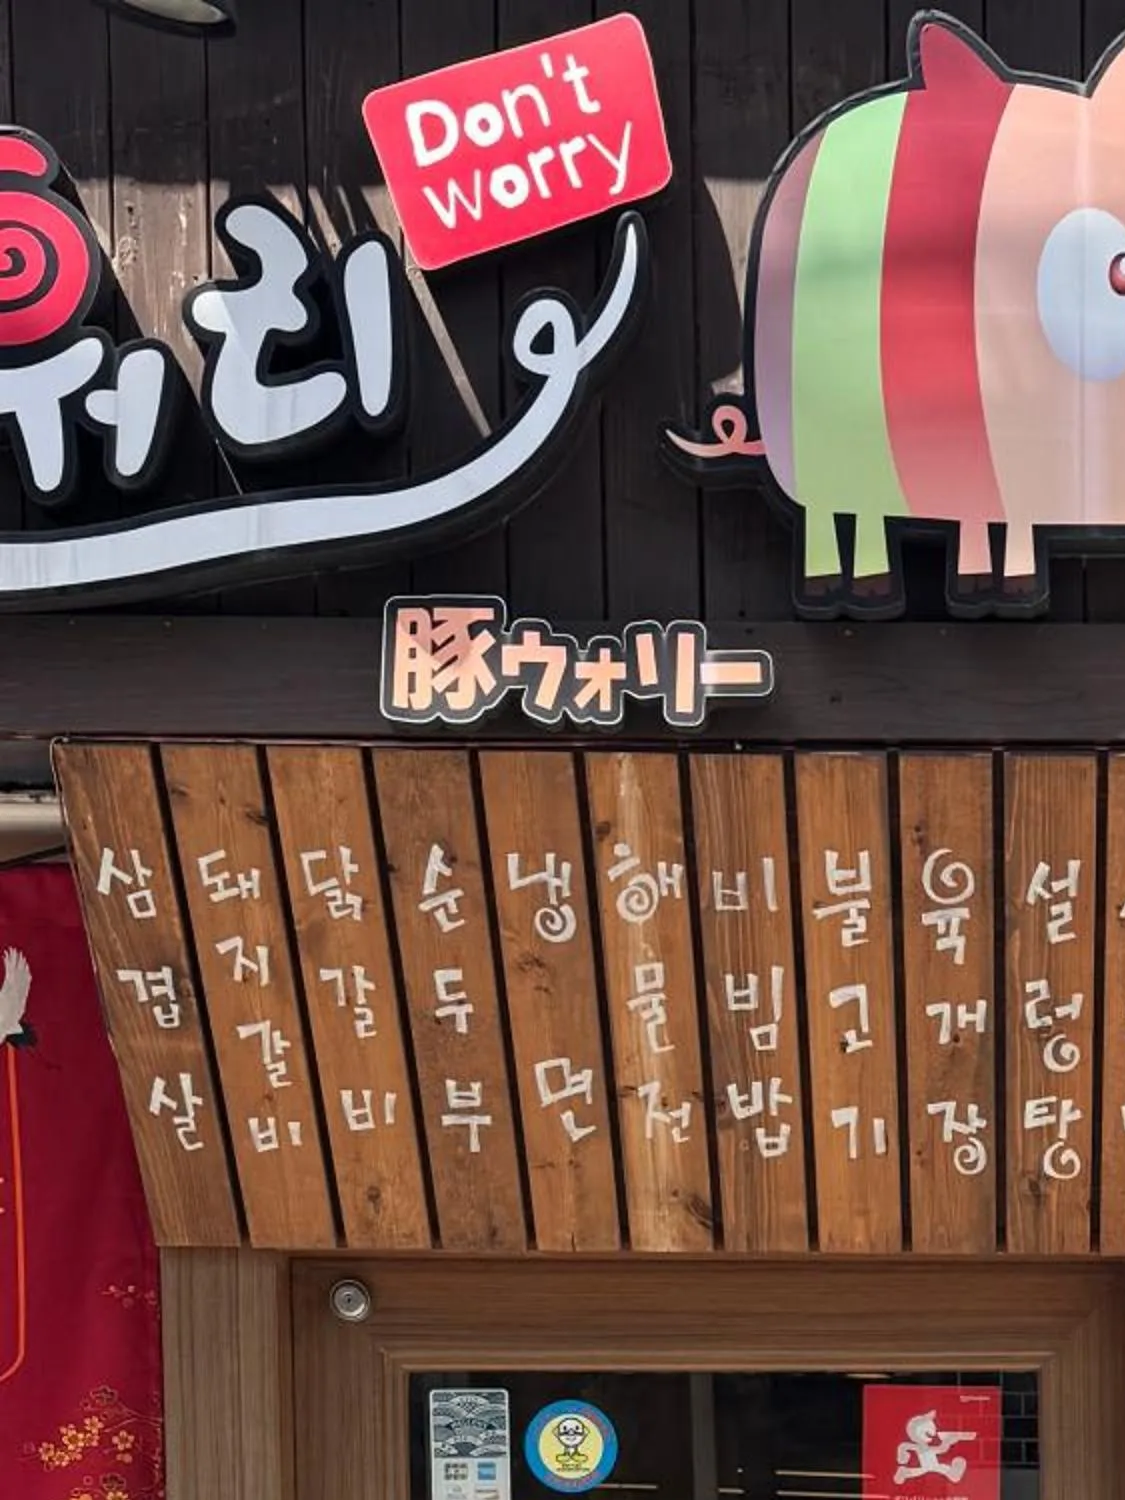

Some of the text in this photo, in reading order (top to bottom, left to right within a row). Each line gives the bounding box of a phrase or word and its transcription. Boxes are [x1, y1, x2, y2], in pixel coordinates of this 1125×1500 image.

[405, 53, 601, 168] Don't
[422, 122, 635, 230] worry
[390, 603, 764, 716] 豚ウォリー
[97, 846, 203, 1151] 삼겹살
[198, 849, 302, 1153] 돼지갈비
[301, 846, 397, 1132] 닭갈비
[417, 844, 492, 1153] 순두부
[507, 852, 597, 1144] 냉면
[608, 844, 692, 1144] 해물전
[713, 857, 793, 1158] 비빔밥
[813, 849, 888, 1159] 불고기
[921, 848, 987, 1176] 육개장
[1024, 859, 1083, 1179] 설렁탕
